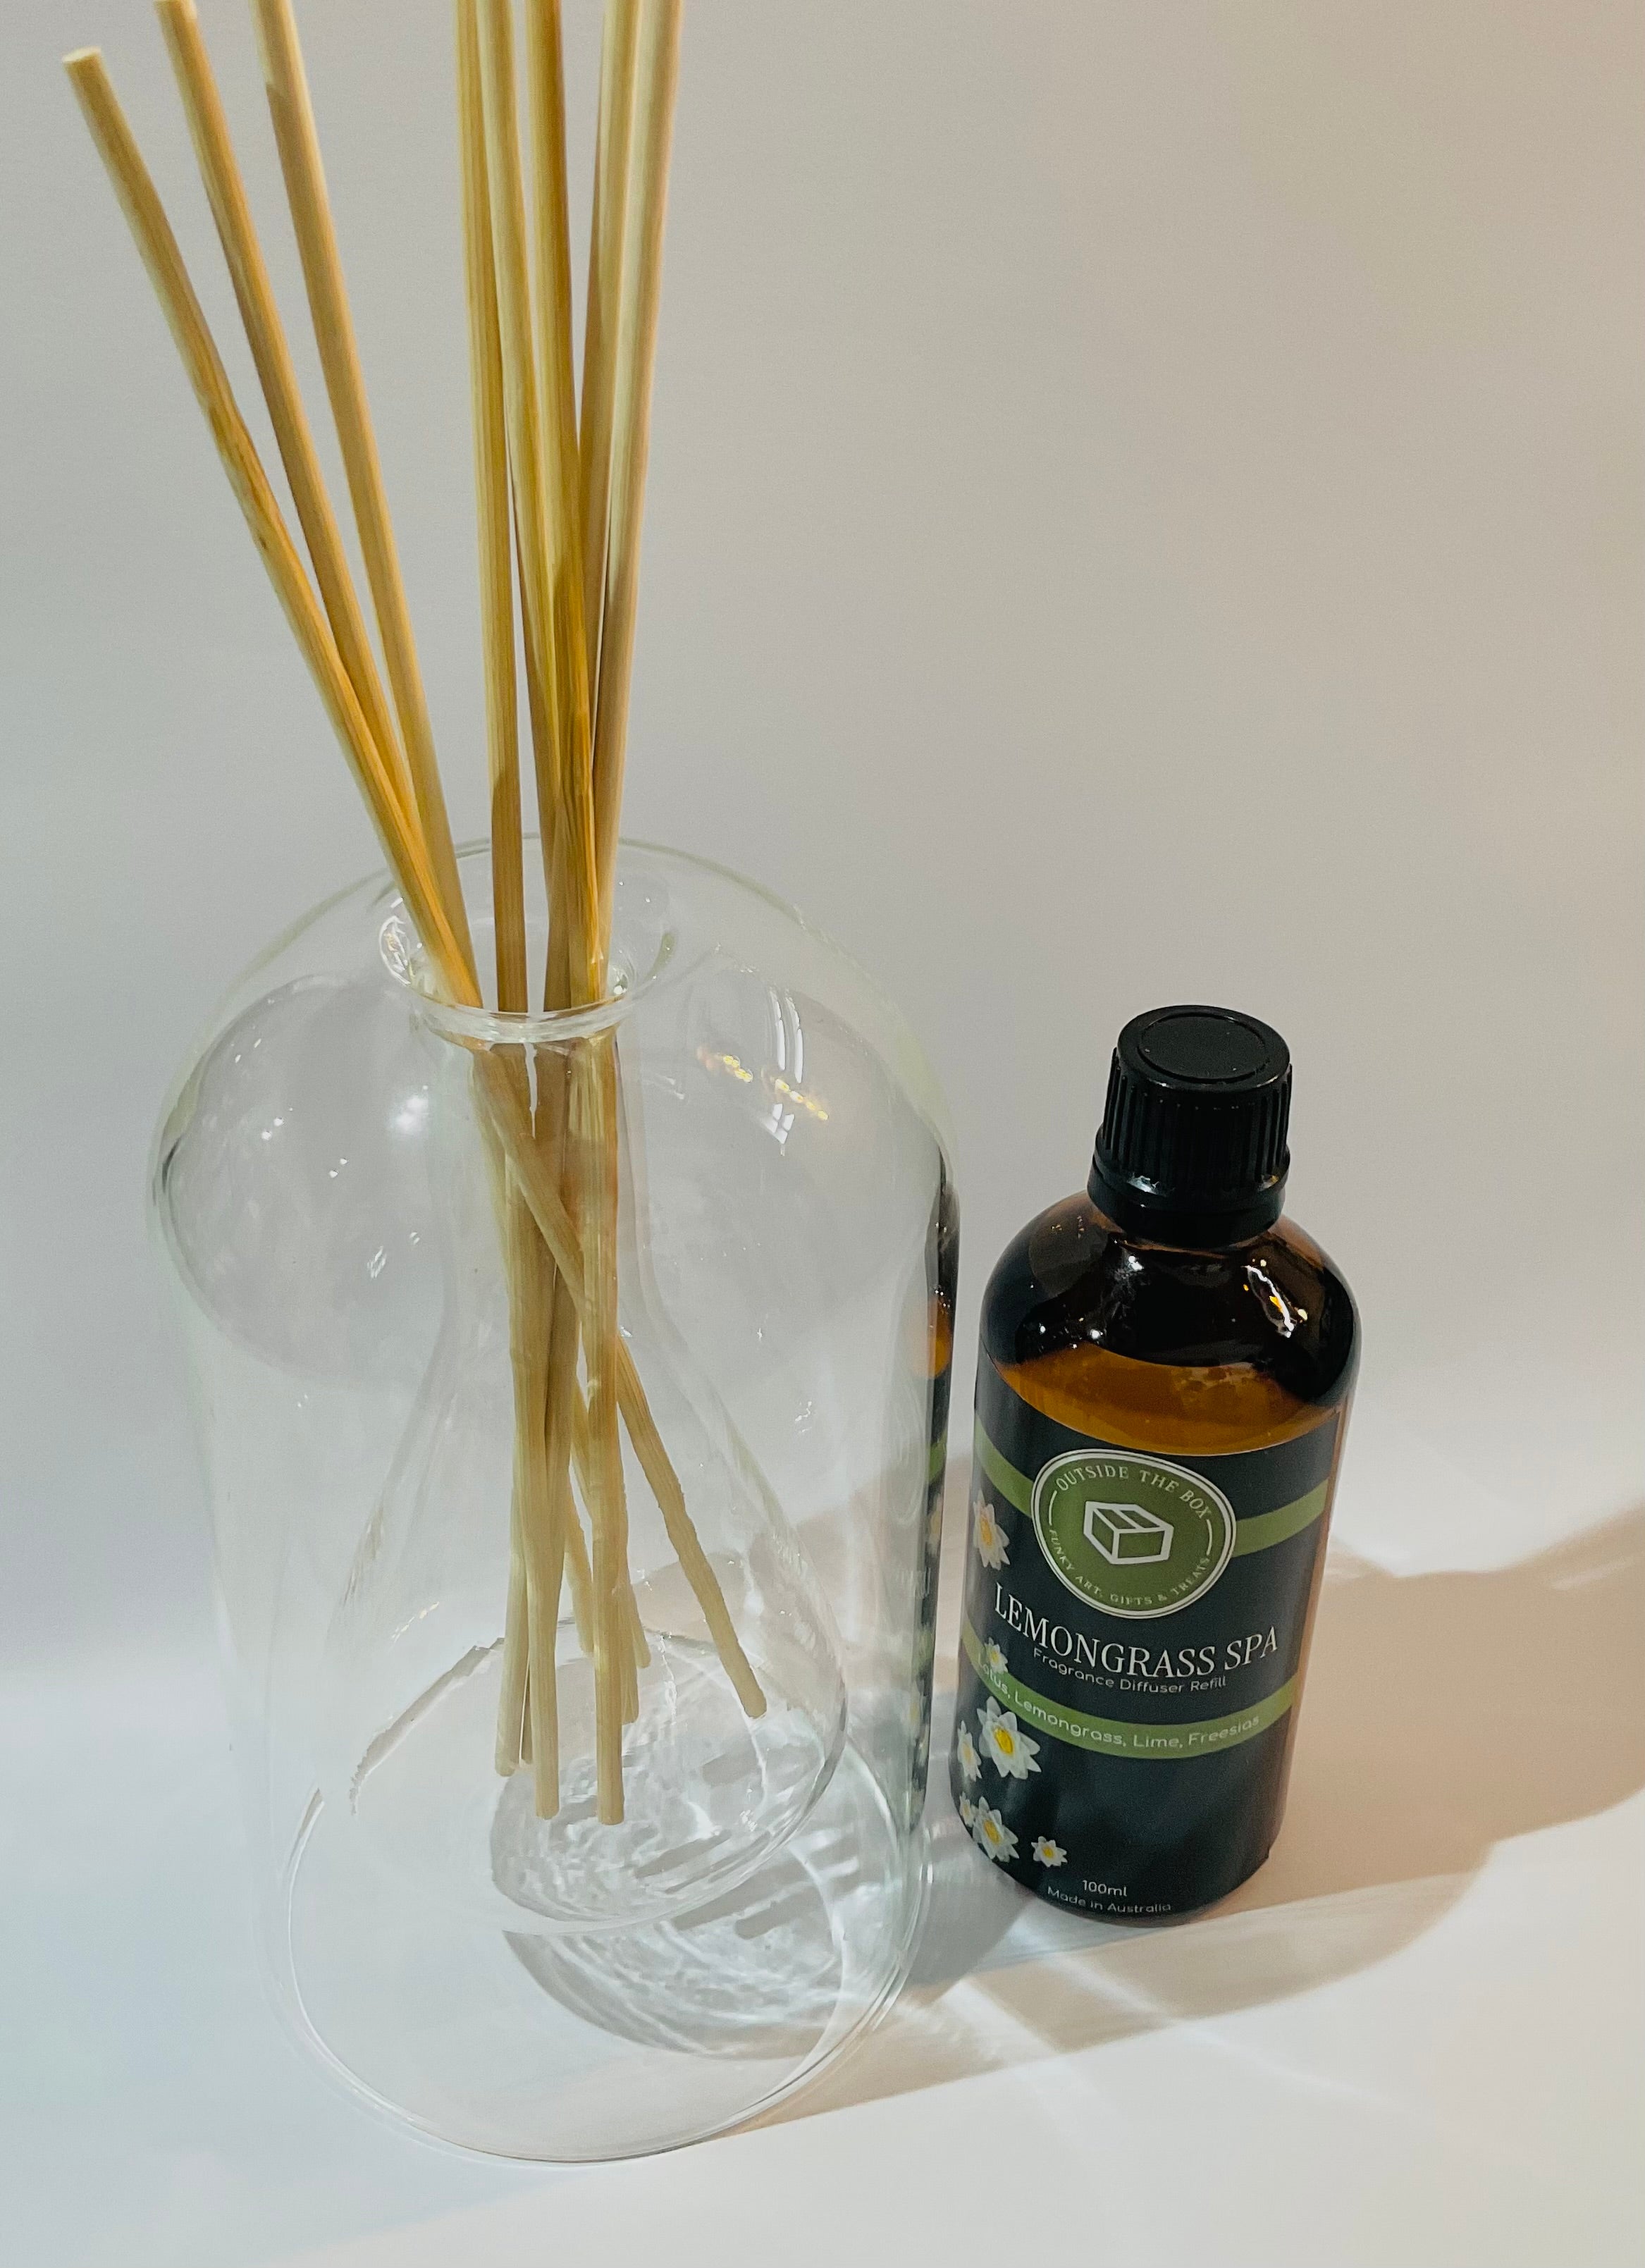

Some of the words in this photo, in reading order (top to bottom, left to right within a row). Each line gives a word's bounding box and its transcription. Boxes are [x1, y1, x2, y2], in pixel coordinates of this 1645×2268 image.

[1056, 1465, 1129, 1492] OUTSIDE
[1139, 1469, 1180, 1493] THE
[1179, 1489, 1212, 1519] BOX
[1049, 1528, 1075, 1571] FUNKY
[1110, 1593, 1153, 1606] GIFTS
[1170, 1556, 1211, 1596] TREATS
[994, 1582, 1216, 1678] LEMONGRASS
[1224, 1626, 1278, 1671] SPA
[1033, 1647, 1115, 1688] Fragrance
[1120, 1678, 1185, 1693] Diffuser
[1190, 1675, 1226, 1691] Refill
[1015, 1690, 1127, 1747] Lemongrass,
[1133, 1734, 1183, 1749] Lime,
[1188, 1715, 1260, 1746] Freesias
[1047, 1886, 1086, 1906] Made
[1090, 1900, 1103, 1911] in
[1107, 1902, 1171, 1913] Australia
[1082, 1880, 1128, 1897] 100ml
